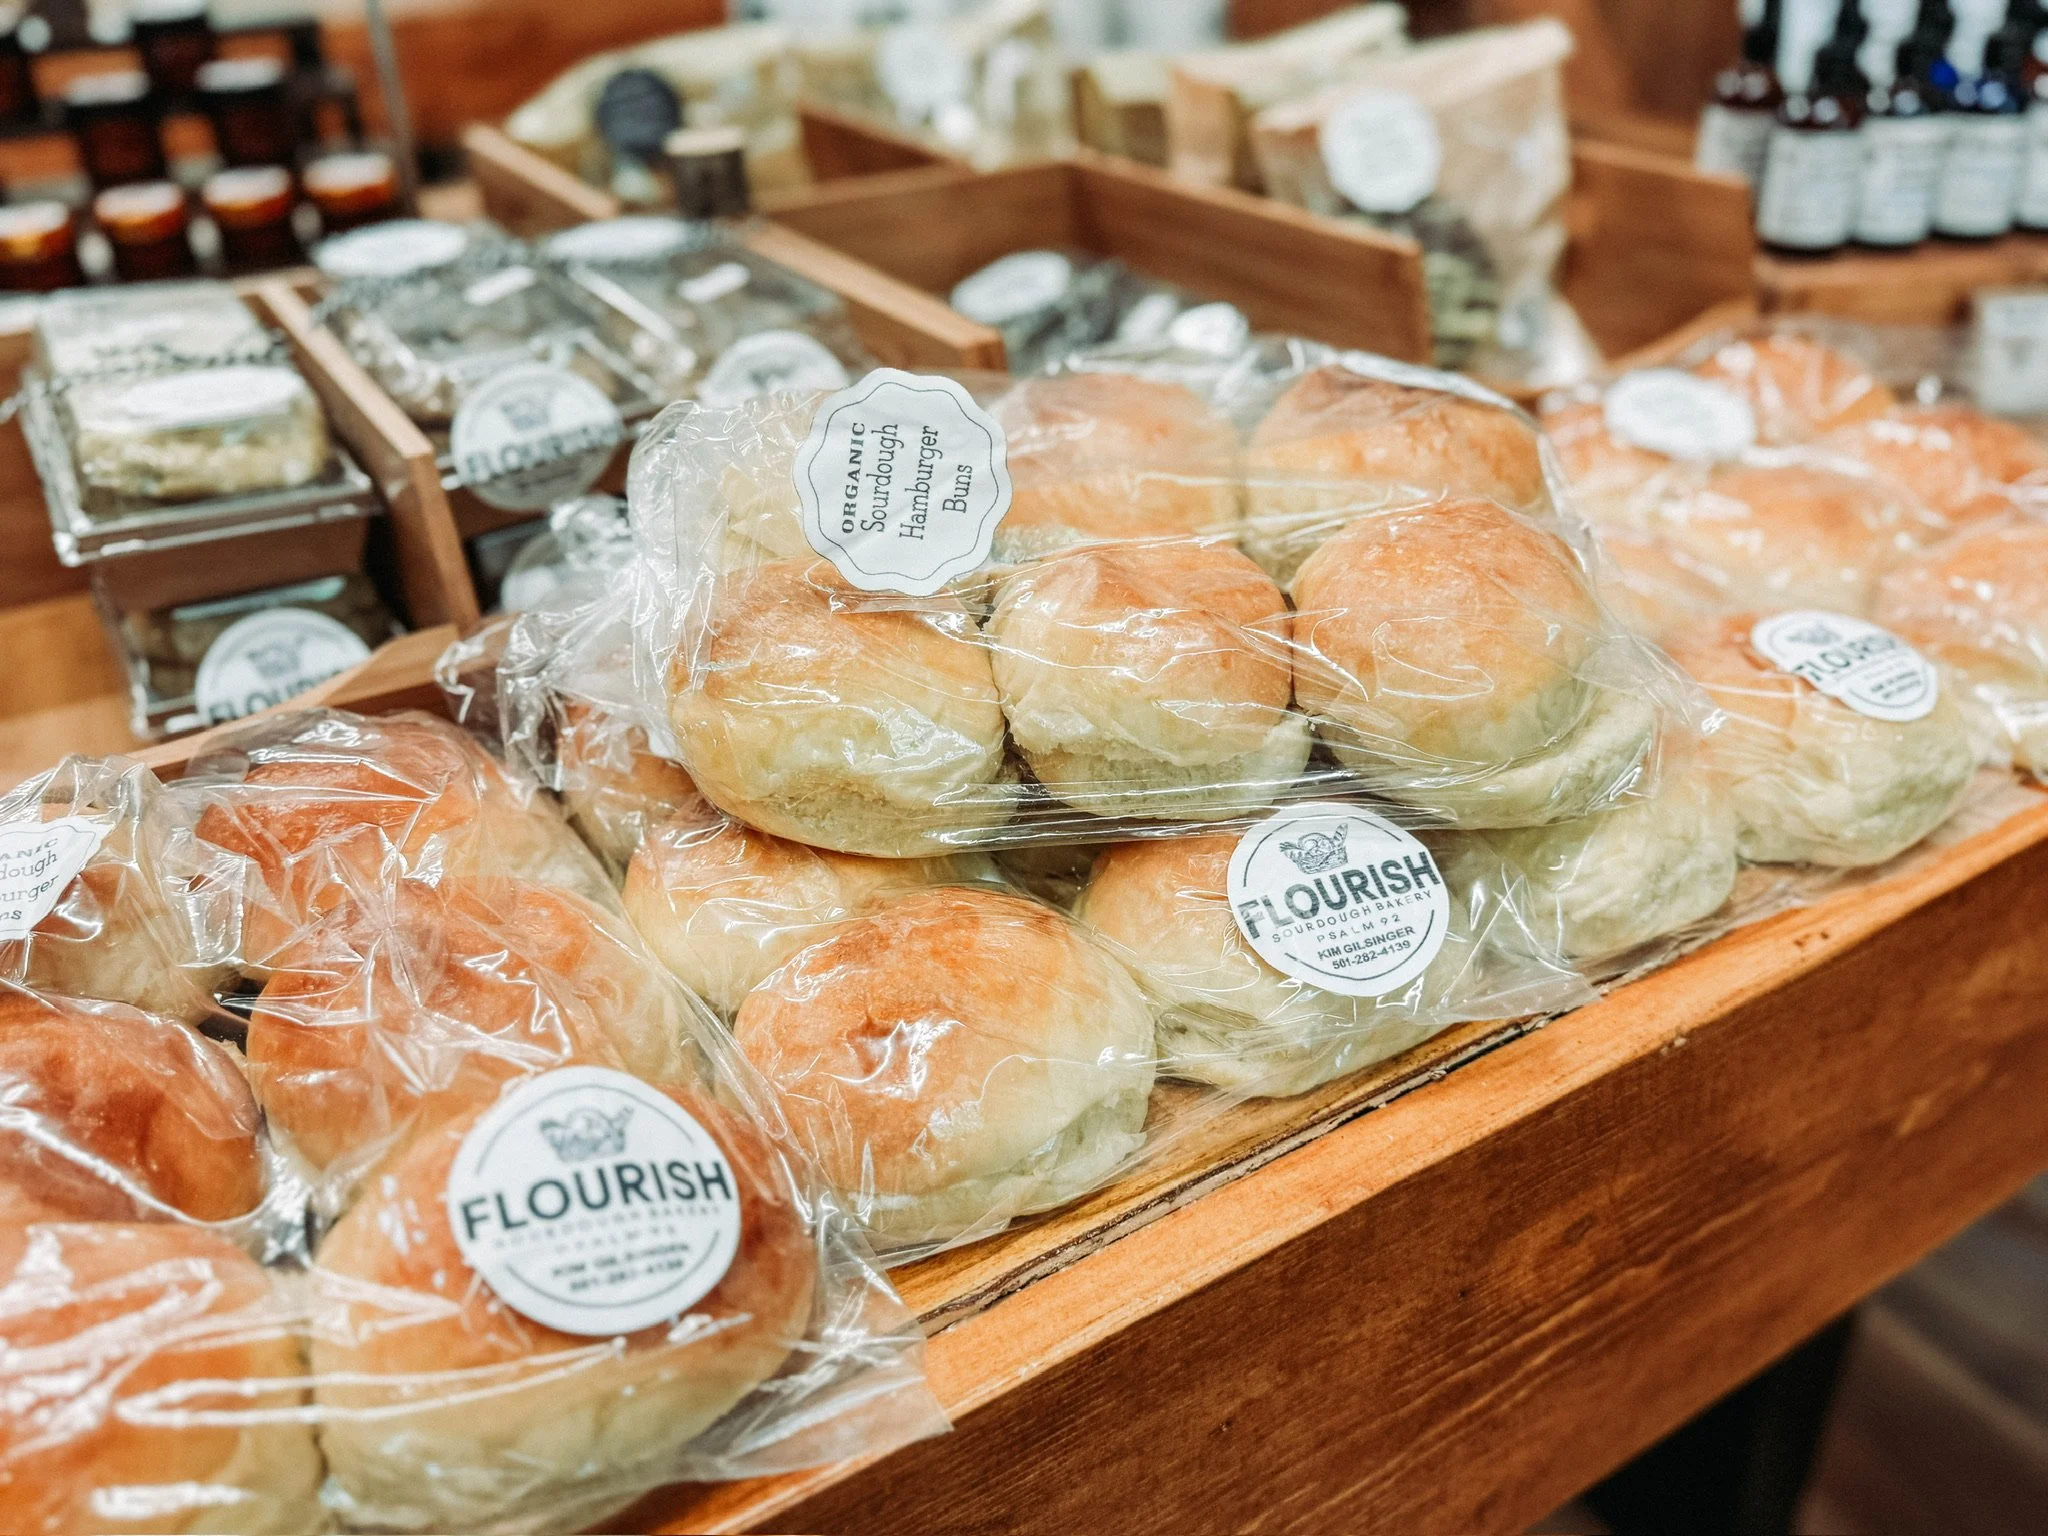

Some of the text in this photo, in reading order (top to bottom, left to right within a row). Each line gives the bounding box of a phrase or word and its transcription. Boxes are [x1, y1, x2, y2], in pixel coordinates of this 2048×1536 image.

[841, 421, 866, 534] ORGANIC
[860, 423, 905, 533] Sourdough
[899, 425, 943, 540] Hamburger
[942, 464, 973, 514] Buns
[1238, 851, 1441, 940] FLOURISH
[1271, 890, 1432, 943] SOURDOUGH BAKERY
[1316, 914, 1401, 943] PSALM 92
[1317, 925, 1416, 961] KIM GILSINGER
[1332, 940, 1412, 970] 501-282-4139
[459, 1160, 732, 1242] FLOURISH
